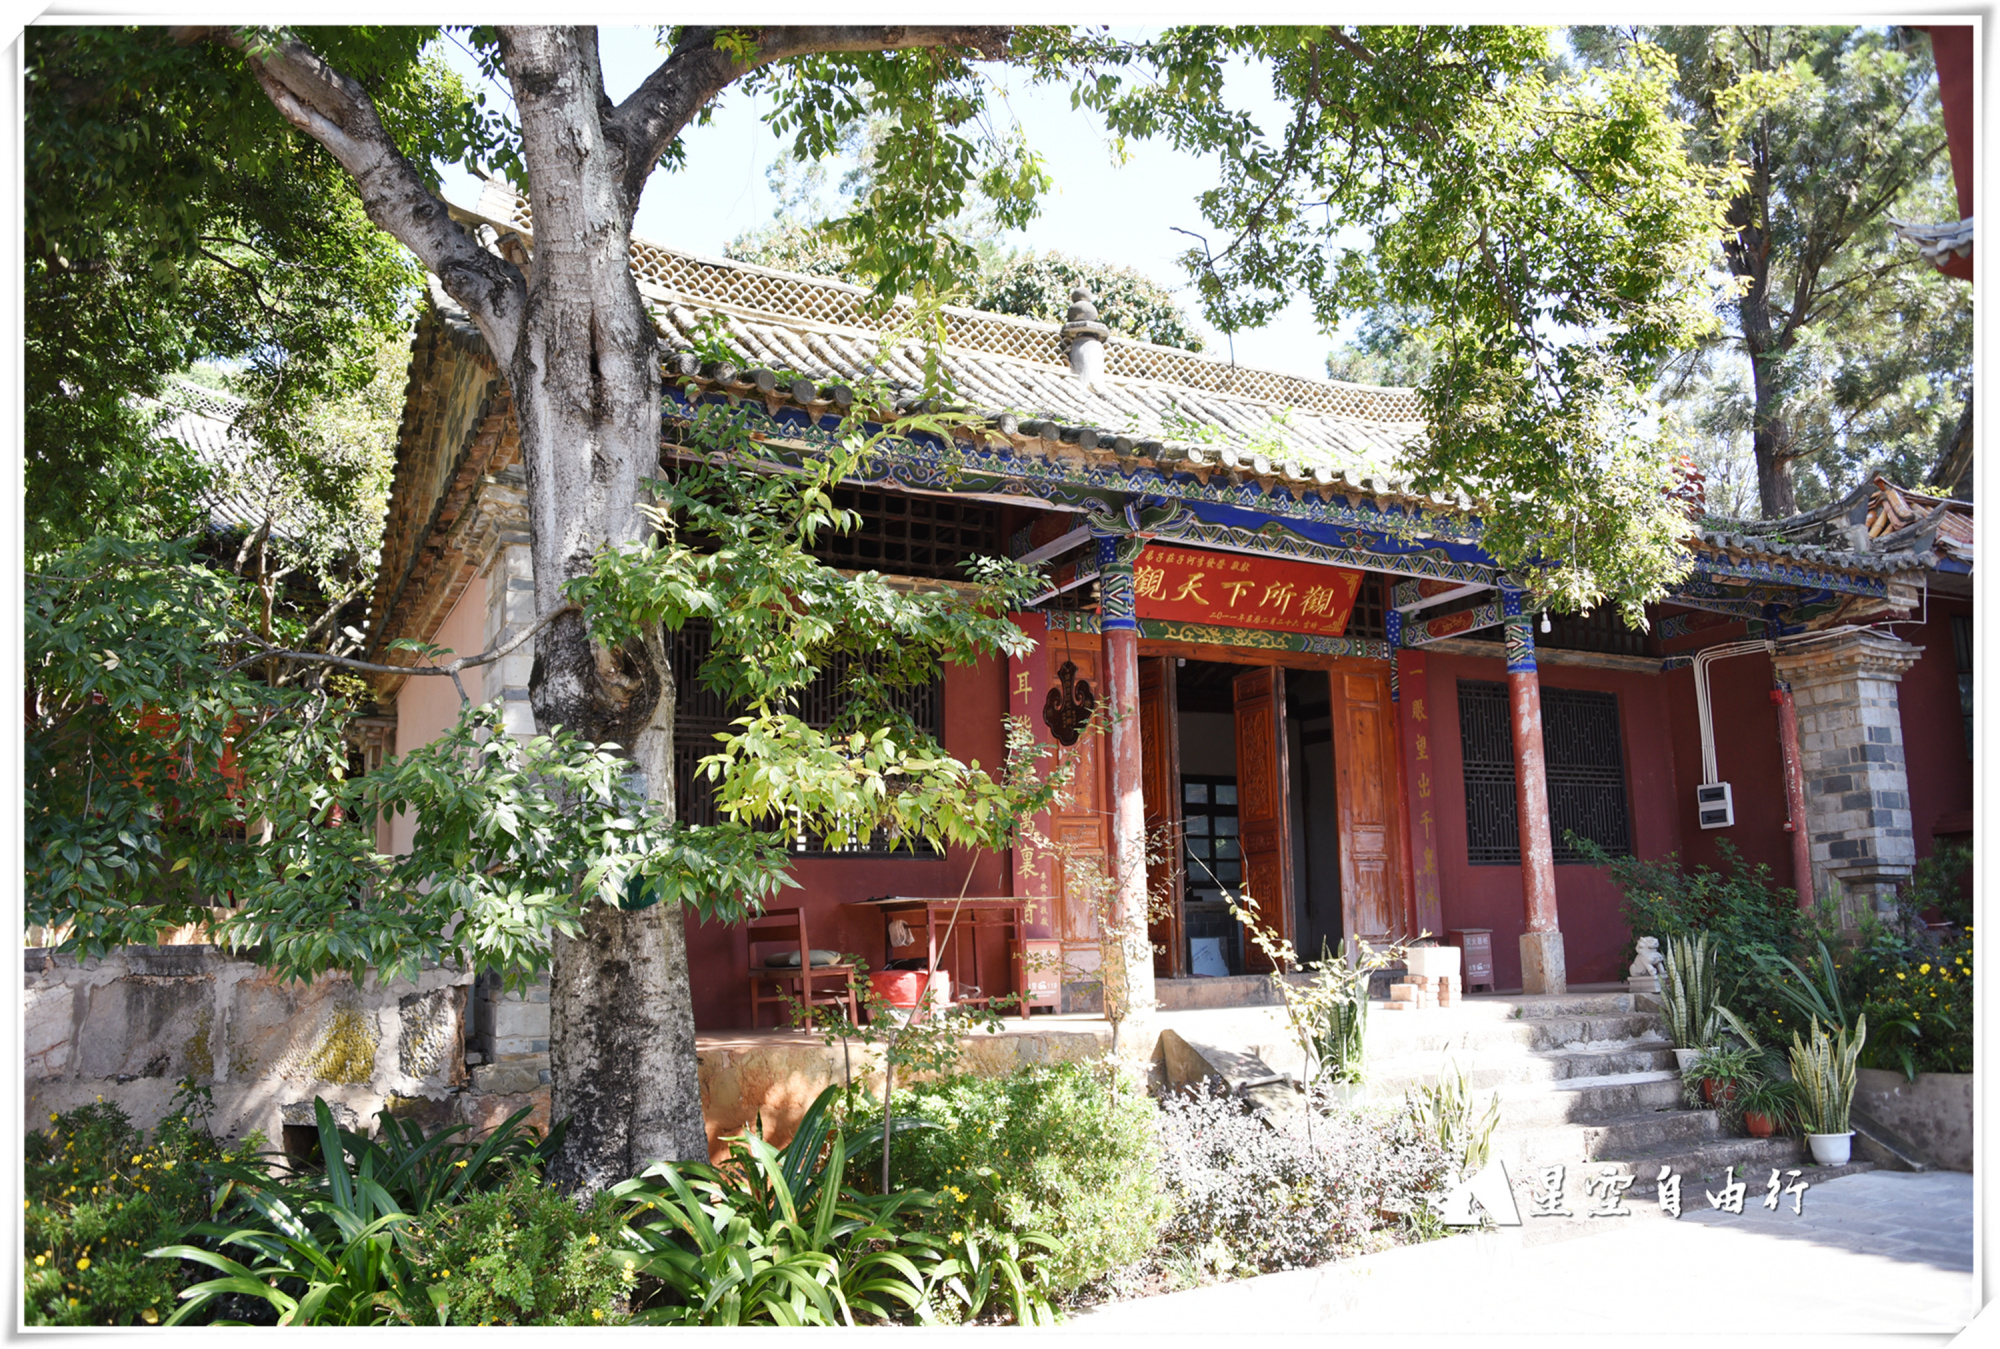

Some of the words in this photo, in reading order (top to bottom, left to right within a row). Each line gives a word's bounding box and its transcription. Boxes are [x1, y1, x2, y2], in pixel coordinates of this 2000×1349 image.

[1133, 564, 1335, 618] 觀天下所觀
